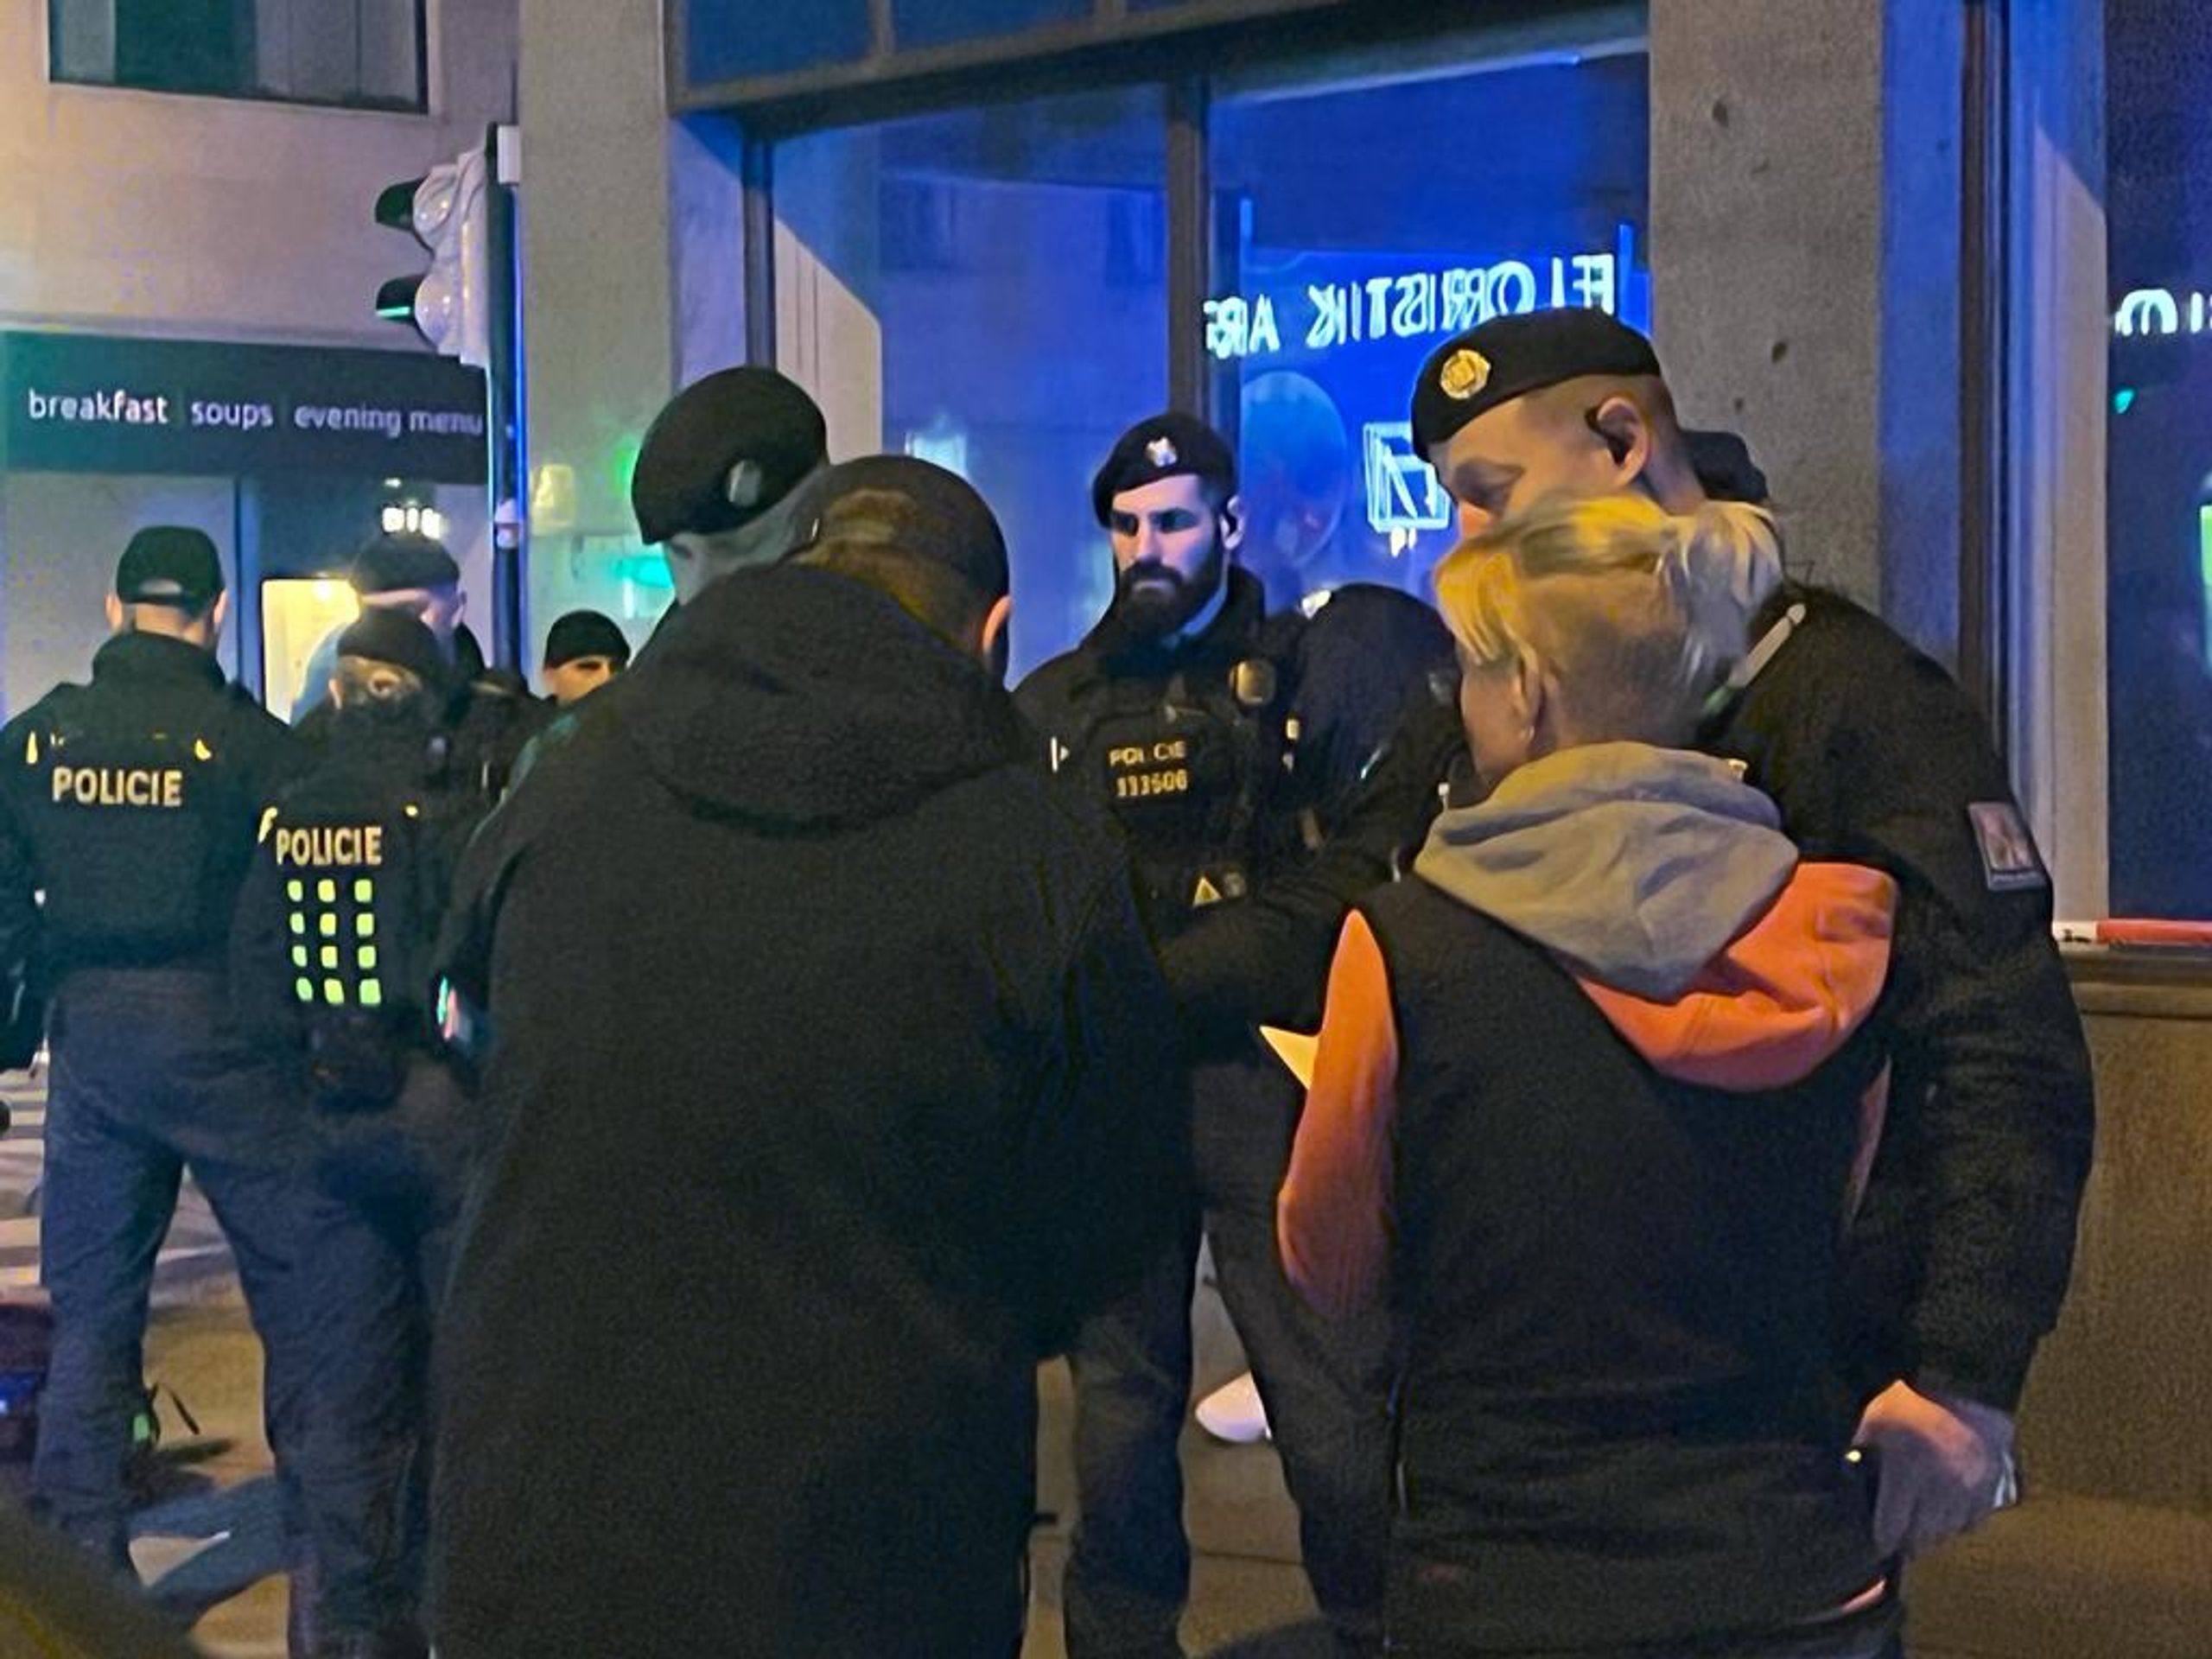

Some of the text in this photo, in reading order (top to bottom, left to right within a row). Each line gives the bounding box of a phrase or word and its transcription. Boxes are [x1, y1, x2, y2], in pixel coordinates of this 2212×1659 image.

[29, 388, 168, 424] breakfast
[191, 400, 274, 430] soups
[295, 404, 484, 438] evening menu
[1109, 741, 1187, 767] POLCIE
[52, 766, 183, 807] POLICIE
[276, 826, 382, 866] POLICIE
